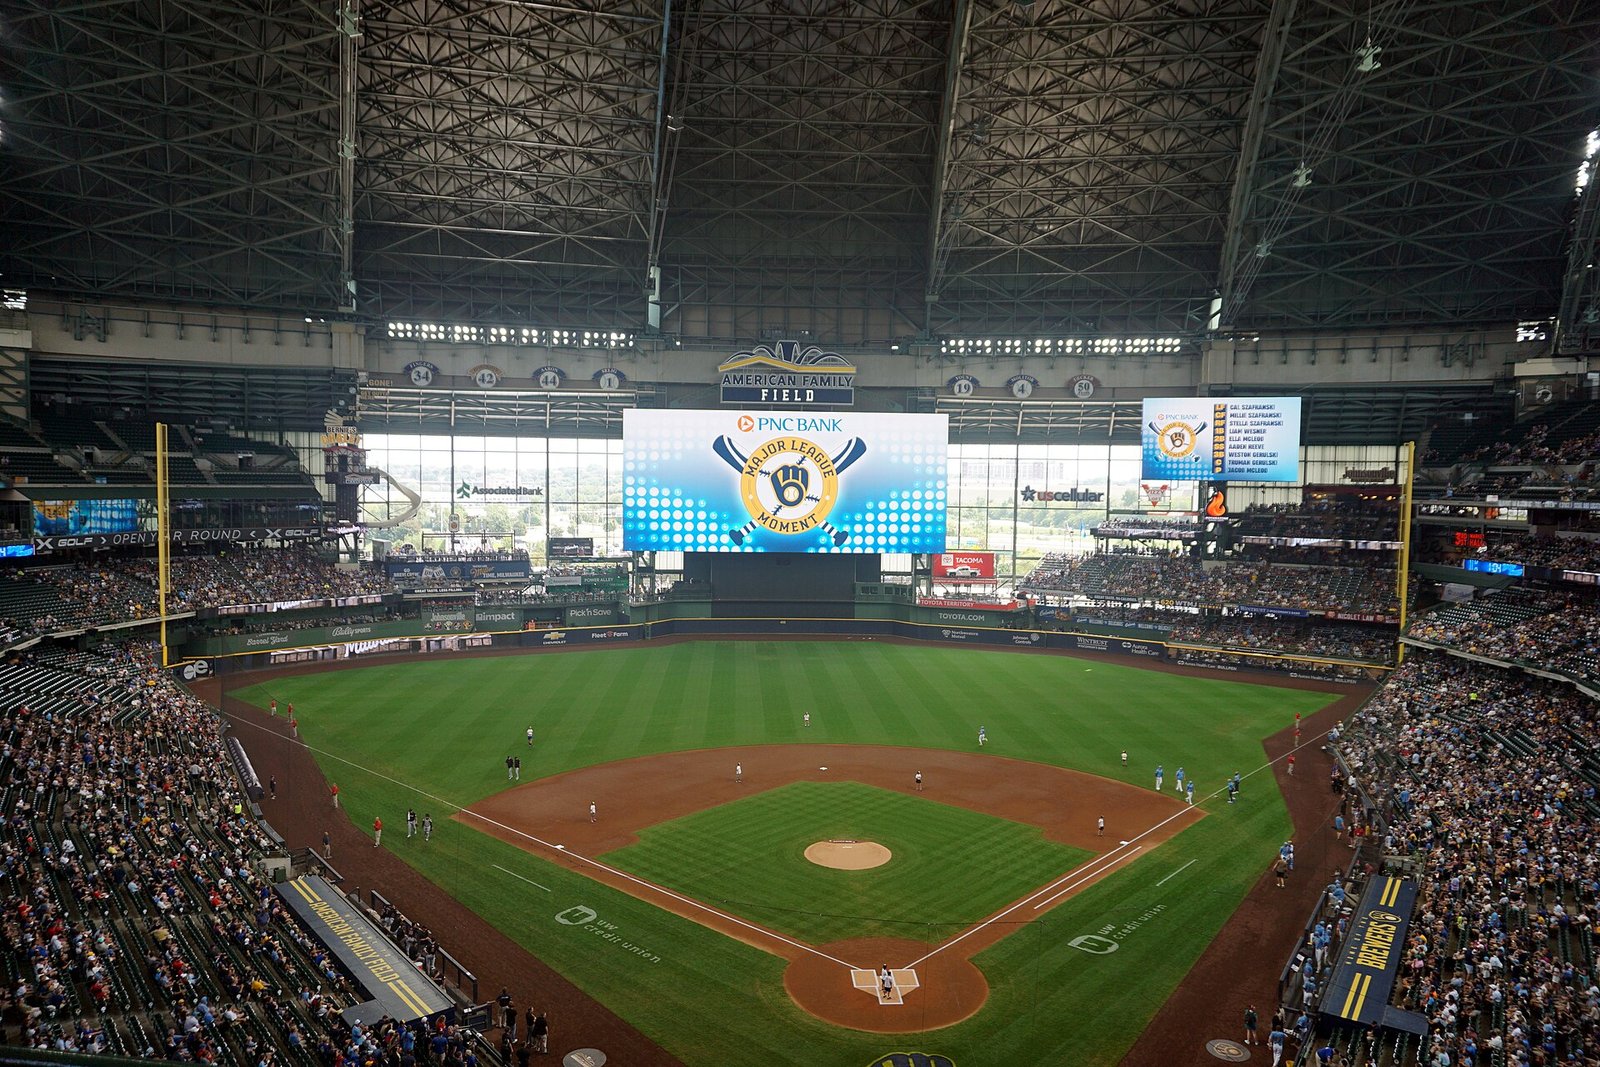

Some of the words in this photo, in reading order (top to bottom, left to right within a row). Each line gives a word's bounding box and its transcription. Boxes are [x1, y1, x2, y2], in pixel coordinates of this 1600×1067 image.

[414, 370, 430, 382] 34
[478, 373, 494, 384] 42
[542, 375, 556, 386] 44
[722, 374, 796, 386] AMERICAN
[802, 375, 853, 387] FAMILY
[607, 378, 612, 388] 1
[956, 383, 970, 394] 19
[1018, 384, 1024, 394] 4
[761, 389, 814, 401] FIELD
[758, 418, 793, 431] PNC
[798, 419, 842, 432] BANK
[745, 440, 786, 477] MAJOR
[791, 440, 834, 478] LEAGUE
[472, 486, 522, 495] Associated
[523, 487, 543, 495] Bank
[758, 512, 818, 532] MOMENT
[113, 533, 146, 544] OPEN
[150, 530, 182, 542] YR
[190, 530, 242, 540] ROUND
[265, 529, 282, 538] X
[36, 538, 54, 550] X
[58, 538, 93, 547] GOLF
[483, 612, 515, 622] impact
[570, 608, 586, 616] Pick
[939, 613, 985, 621] TOYOTA.COM
[332, 627, 354, 637] Bally
[247, 637, 270, 646] Barrel
[270, 635, 288, 645] Yard
[1077, 637, 1108, 645] WINTRUST
[597, 920, 618, 930] uw
[1113, 921, 1142, 940] credit
[1138, 904, 1167, 921] union
[310, 900, 350, 936] AMERICAN
[343, 931, 378, 965] FAMILY
[364, 957, 400, 983] FIELD
[584, 924, 621, 943] credit
[622, 942, 661, 963] union
[1356, 921, 1397, 970] BREWERS
